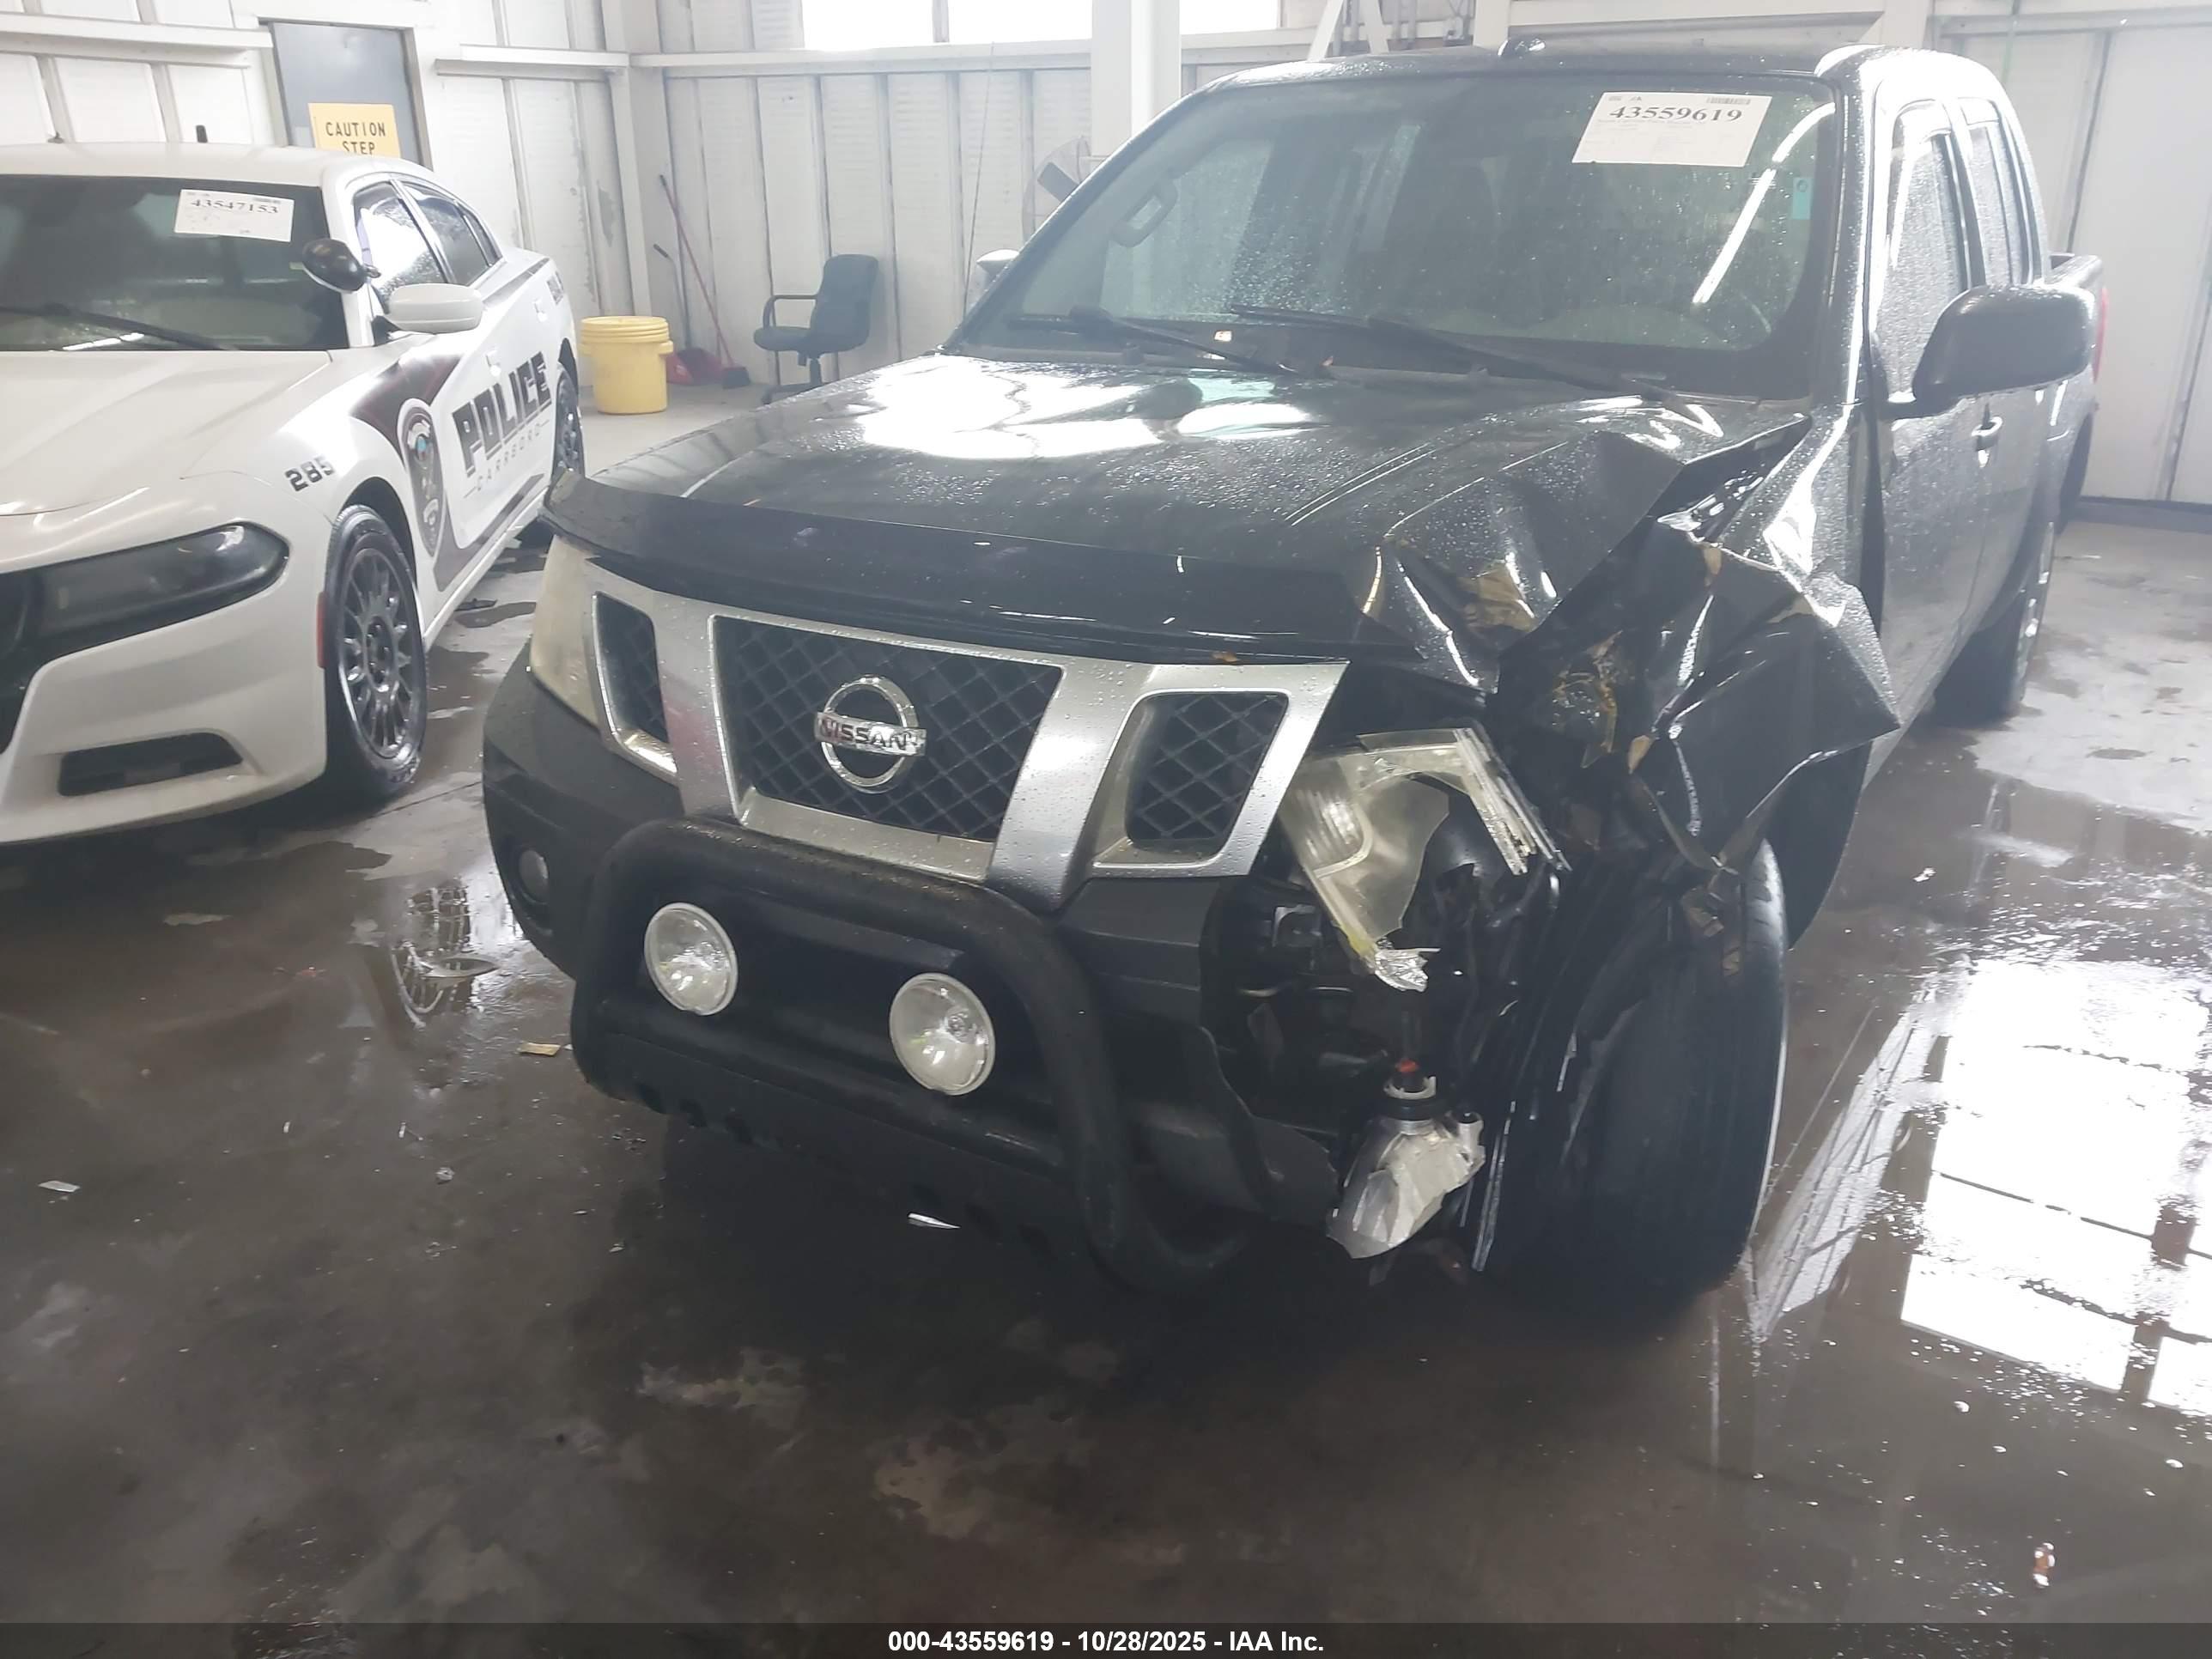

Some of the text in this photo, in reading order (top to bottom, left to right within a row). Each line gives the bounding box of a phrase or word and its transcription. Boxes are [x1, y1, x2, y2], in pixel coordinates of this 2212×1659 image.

[1609, 106, 1742, 122] 43559619
[325, 121, 386, 137] CAUTION
[342, 141, 376, 155] STEP
[191, 198, 279, 214] 43547153
[452, 351, 552, 478] POLICE
[284, 455, 335, 492] 285
[820, 716, 916, 750] NISSAN
